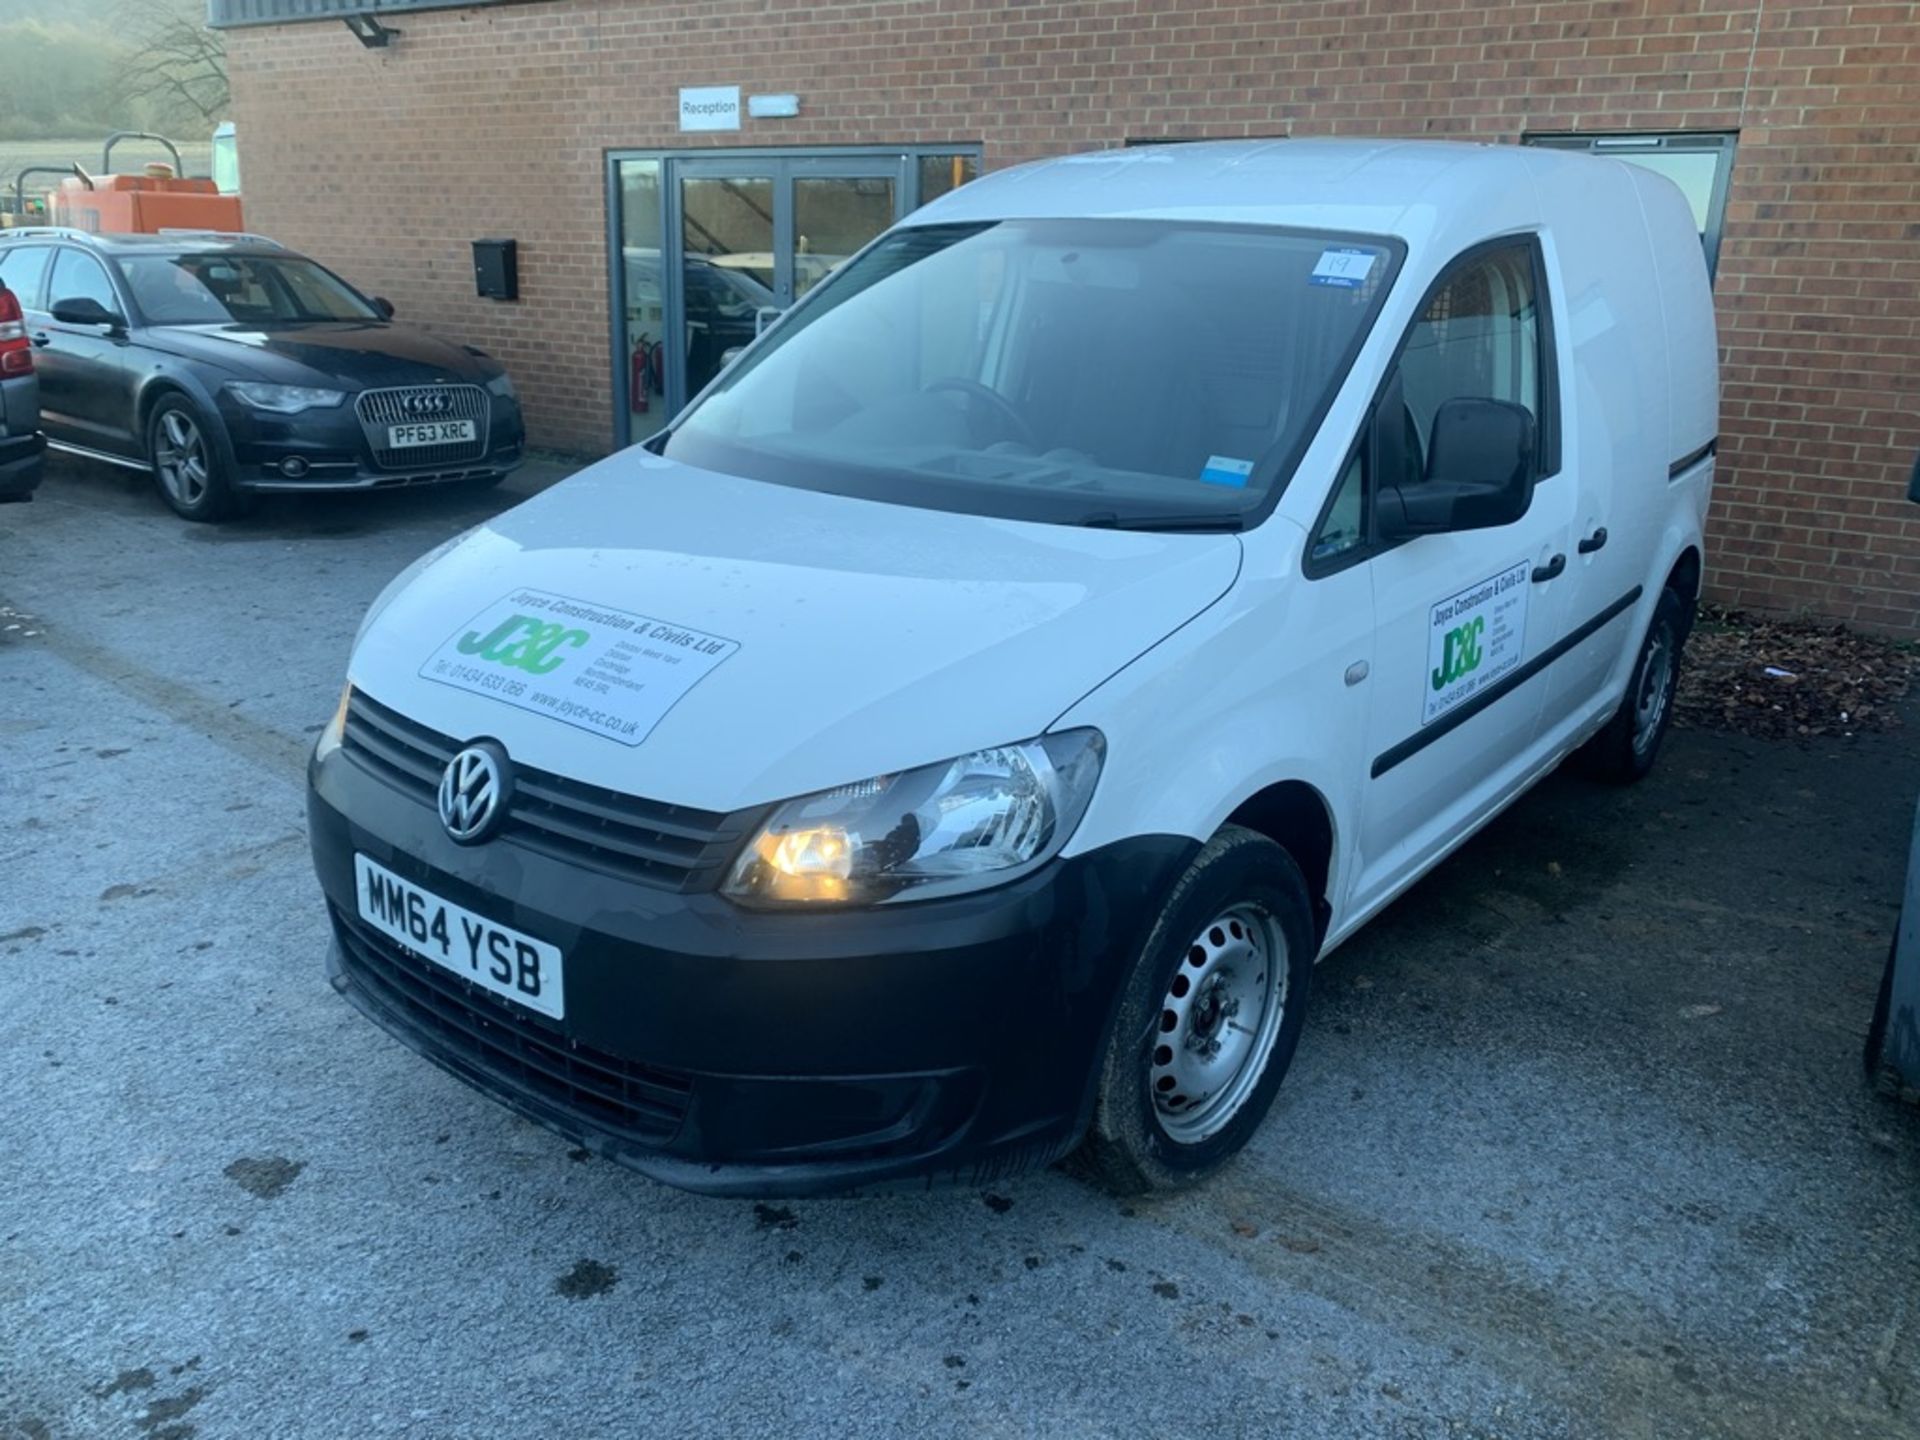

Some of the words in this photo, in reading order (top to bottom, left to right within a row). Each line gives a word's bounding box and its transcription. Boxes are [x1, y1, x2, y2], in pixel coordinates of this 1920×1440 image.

[682, 101, 736, 116] Reception
[395, 425, 436, 443] PF63
[440, 423, 467, 439] XRC
[510, 592, 550, 609] Joyce
[548, 599, 635, 630] Construction
[634, 621, 652, 635] &
[649, 625, 694, 648] Civils
[693, 638, 726, 656] Ltd
[1433, 605, 1453, 626] Joyce
[1455, 586, 1493, 615] Construction
[449, 664, 482, 683] 01434
[481, 673, 504, 690] 633
[502, 680, 528, 697] 066
[530, 691, 639, 736] www.joyce-cc.co.uk
[367, 866, 450, 956] MM64
[461, 916, 541, 997] YSB
